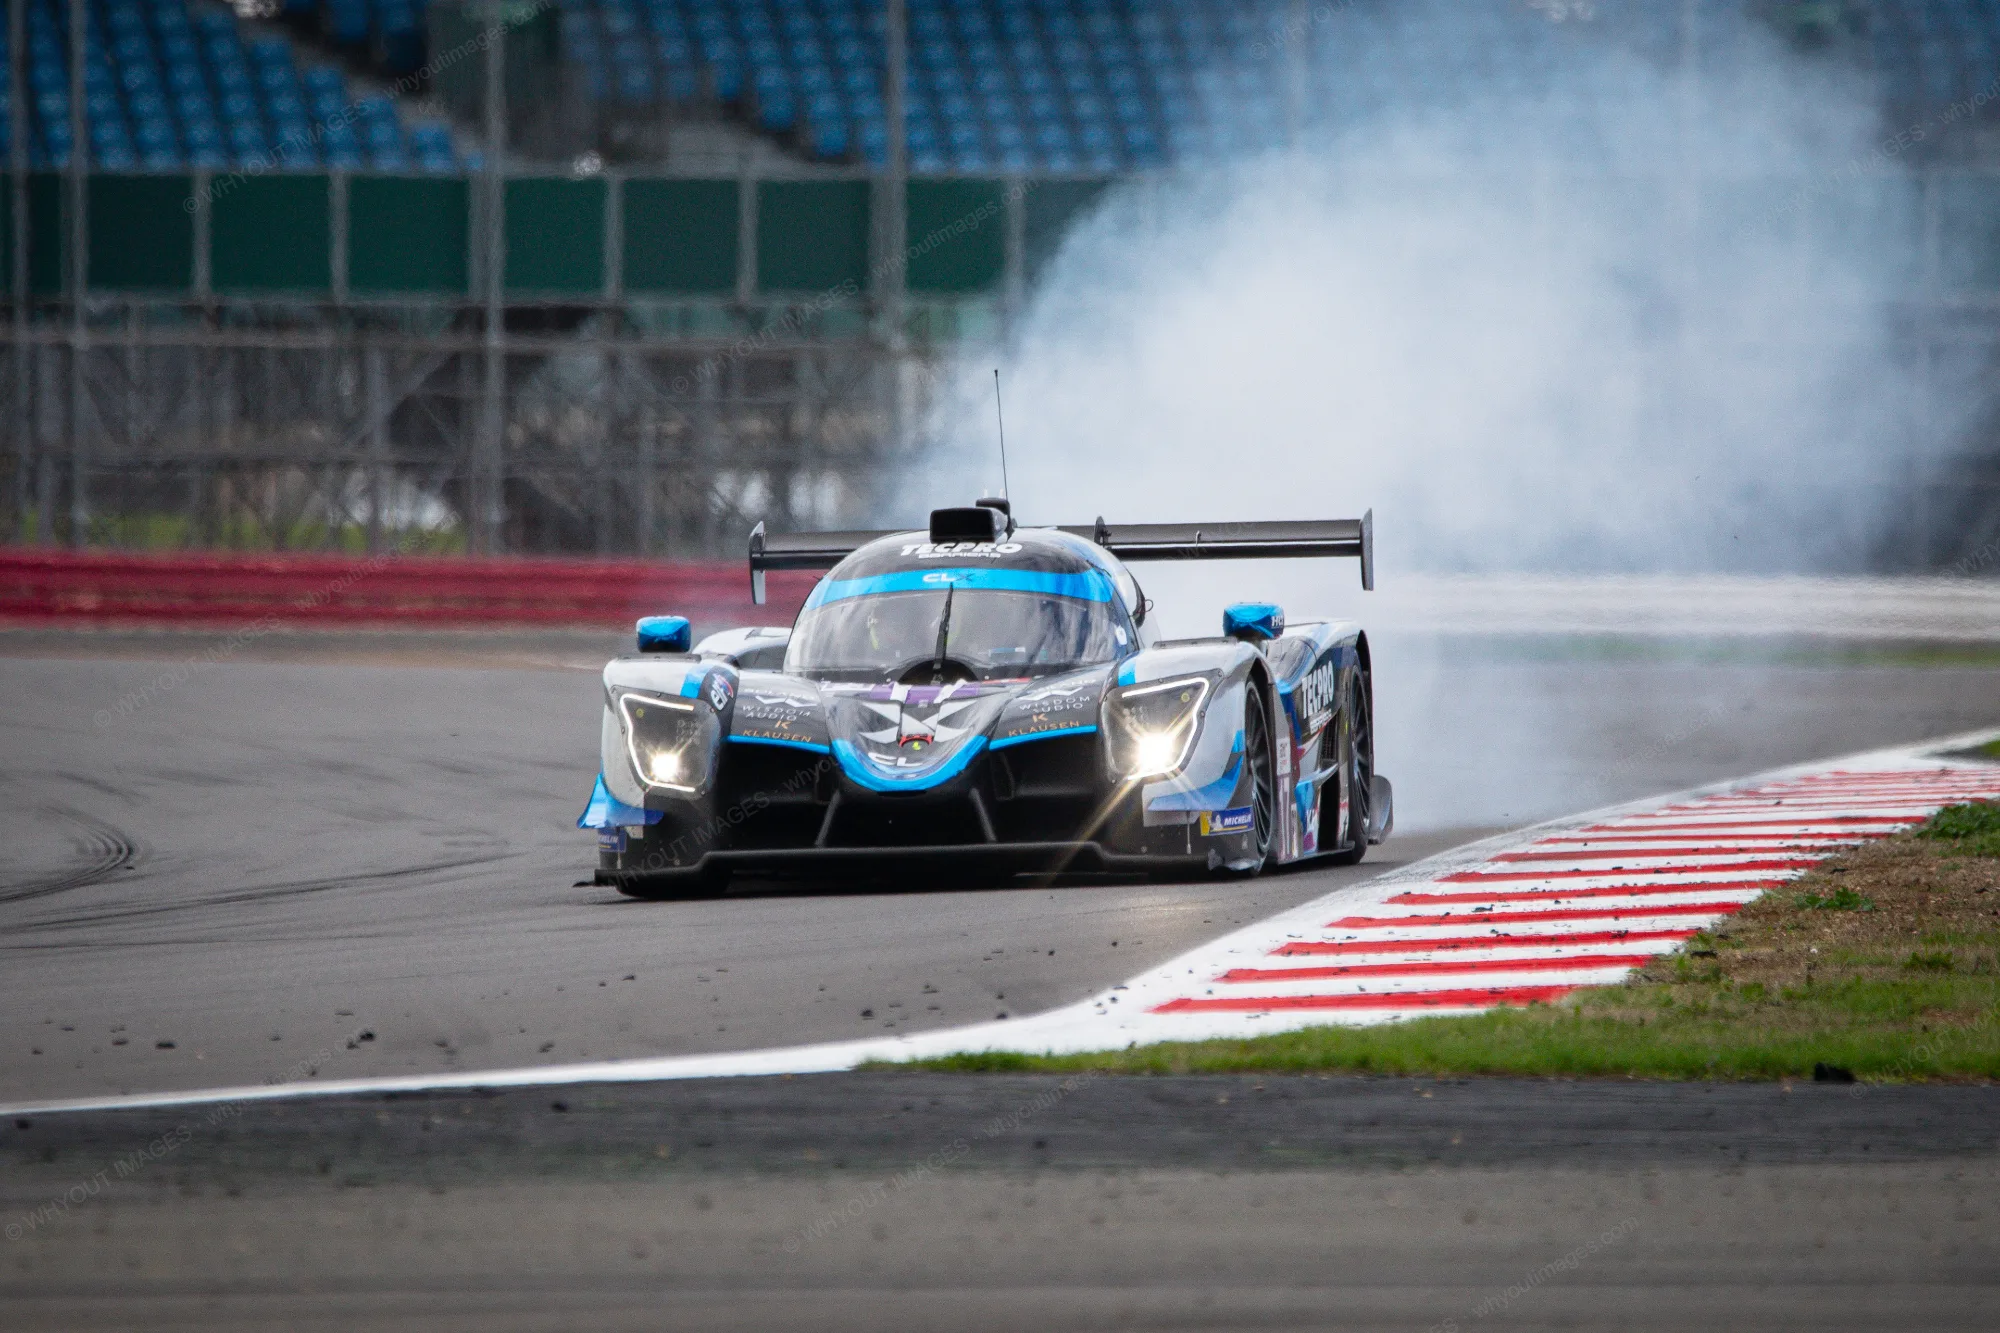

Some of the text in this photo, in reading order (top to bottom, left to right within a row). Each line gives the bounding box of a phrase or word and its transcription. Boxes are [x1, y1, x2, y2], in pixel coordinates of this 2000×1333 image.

[900, 541, 1023, 557] TECPRO
[742, 729, 812, 743] KLAUSEN
[1007, 720, 1080, 738] KLAUSEN
